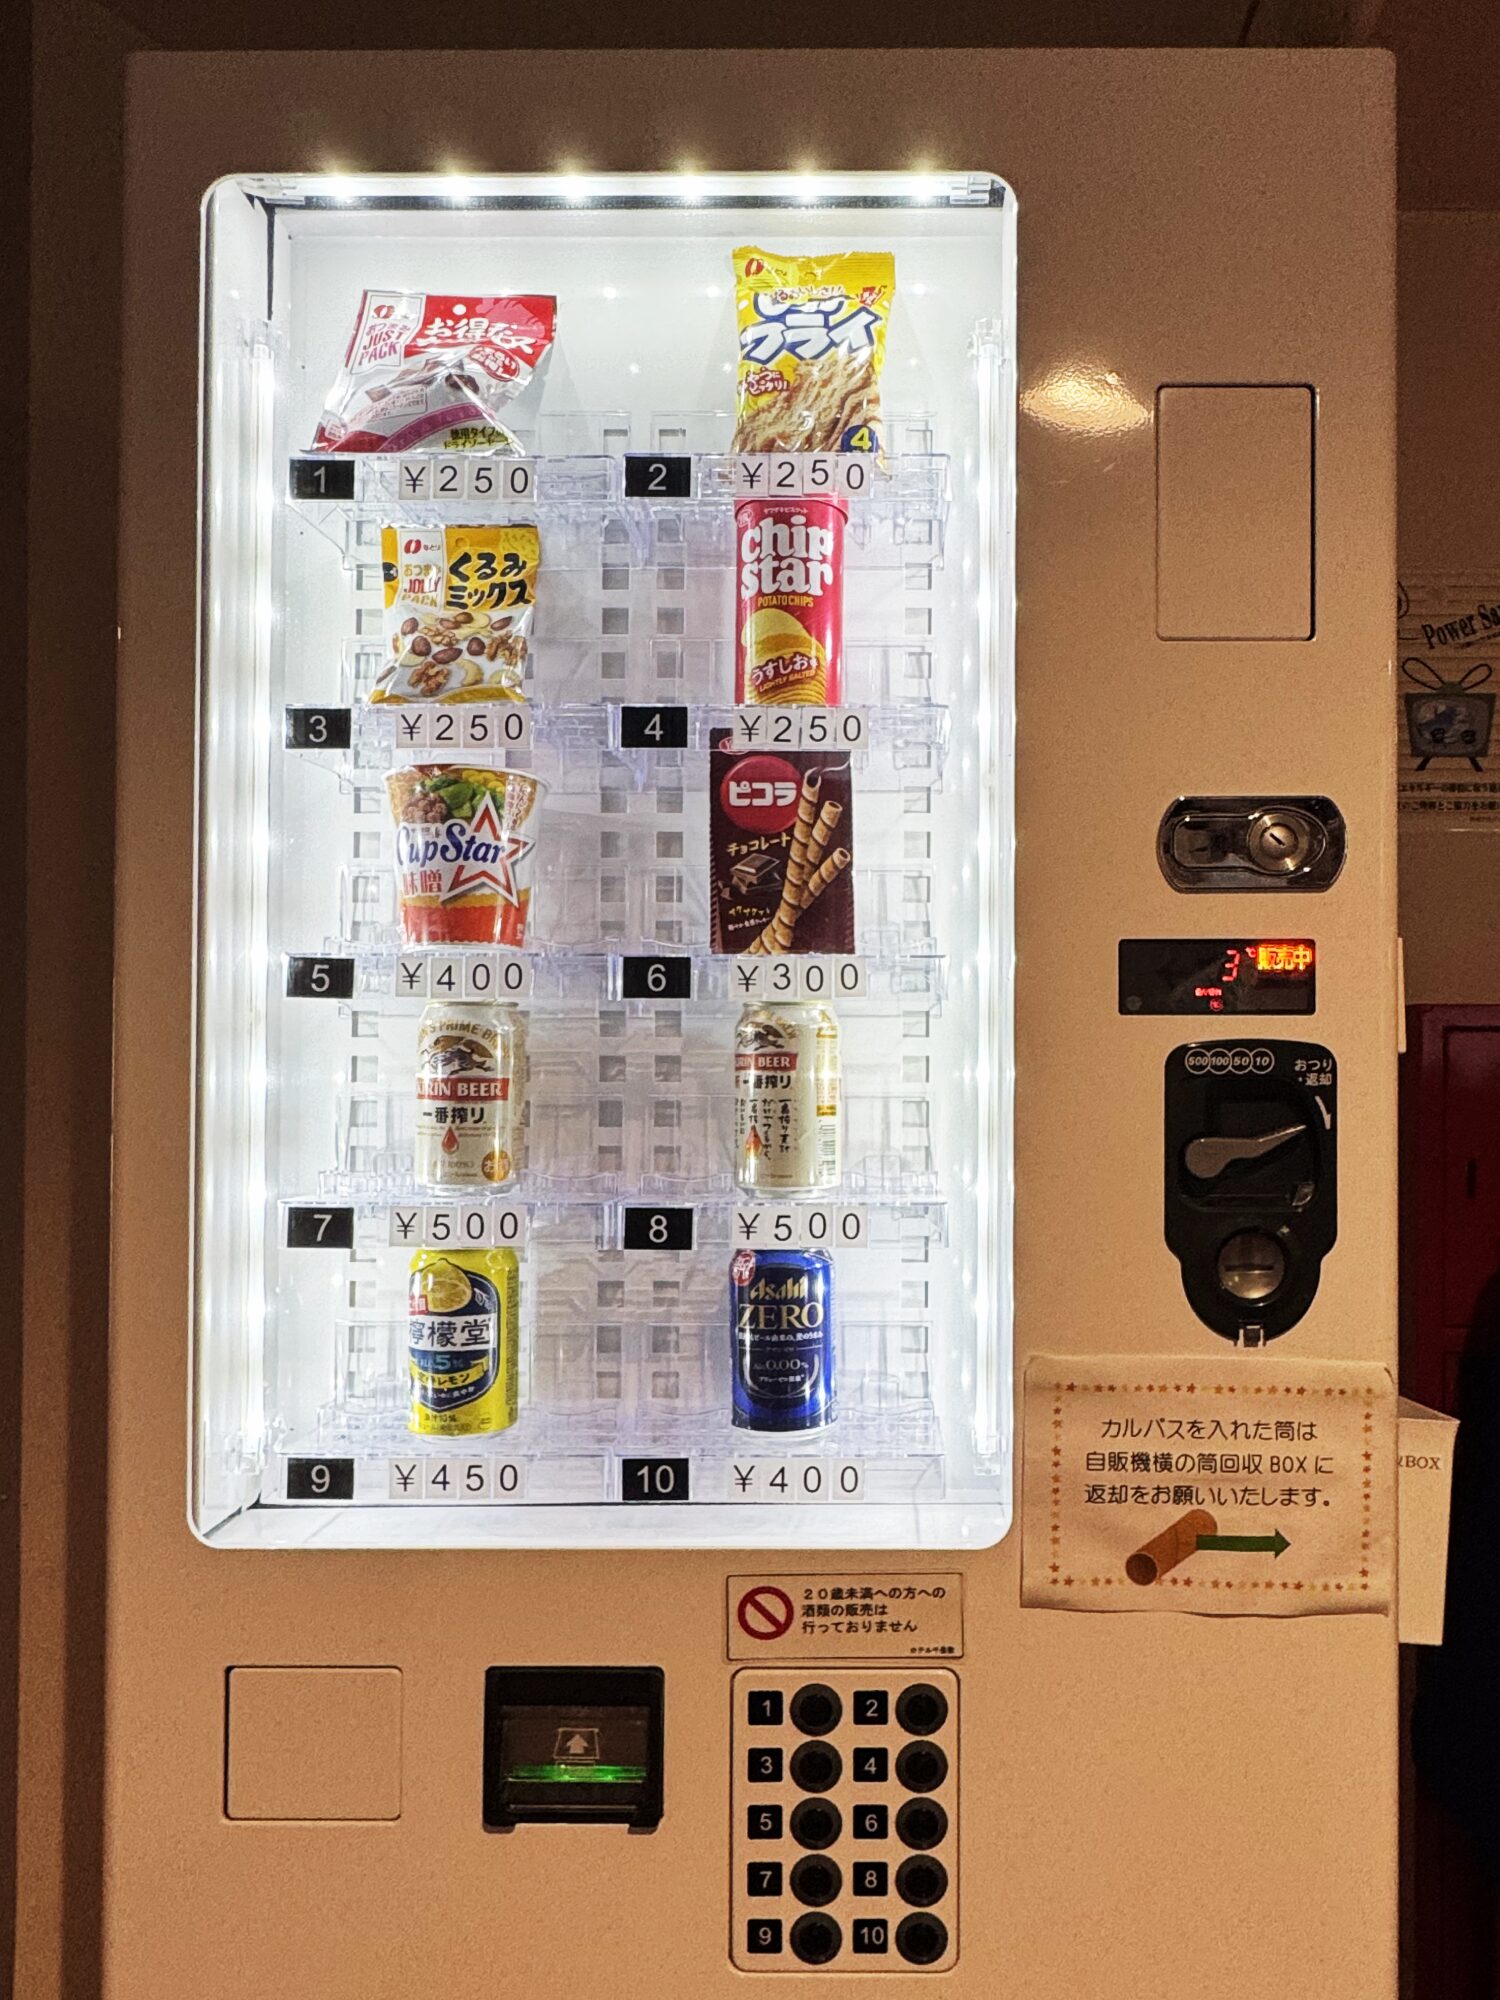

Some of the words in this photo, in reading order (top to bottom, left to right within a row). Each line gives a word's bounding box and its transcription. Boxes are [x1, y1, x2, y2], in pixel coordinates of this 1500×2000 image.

[363, 330, 404, 350] JUST
[850, 427, 872, 450] 4
[313, 466, 326, 492] 1
[404, 466, 529, 493] ¥250
[648, 463, 667, 491] 2
[741, 460, 864, 489] ¥250
[741, 515, 833, 562] chip
[449, 552, 527, 582] くるみ
[741, 554, 833, 598] star
[446, 579, 532, 609] ミックス
[1421, 614, 1476, 649] Power
[309, 716, 327, 742] 3
[401, 713, 523, 741] ¥250
[644, 714, 663, 741] 4
[740, 715, 861, 743] ¥250
[729, 781, 797, 807] ピコラ
[726, 832, 791, 856] チョコレート
[1222, 949, 1240, 982] 3
[1257, 944, 1312, 971] 販売中
[311, 965, 330, 992] 5
[401, 962, 523, 991] ¥400
[647, 964, 666, 991] 6
[737, 964, 858, 992] ¥300
[757, 1056, 791, 1068] BEER
[1188, 1056, 1209, 1066] 500
[1211, 1056, 1229, 1066] 100
[1233, 1056, 1249, 1066] 50
[1256, 1056, 1270, 1066] 10
[1294, 1059, 1332, 1072] おつり
[457, 1082, 504, 1097] BEER
[423, 1106, 485, 1124] 一番搾り
[313, 1214, 332, 1242] 7
[395, 1212, 518, 1241] ¥500
[649, 1215, 668, 1243] 8
[738, 1212, 861, 1241] ¥500
[750, 1277, 806, 1300] Asahi
[738, 1302, 824, 1330] ZERO
[1101, 1418, 1318, 1441] カルパスを入れた筒は
[395, 1464, 518, 1492] ¥450
[1269, 1455, 1308, 1475] BOX
[311, 1465, 330, 1493] 9
[637, 1465, 675, 1493] 10
[734, 1465, 858, 1493] ¥400
[1085, 1484, 1331, 1508] 返却をお願いいたします。
[802, 1603, 888, 1618] 酒類の販売は
[802, 1620, 918, 1635] 行っておりません
[762, 1699, 771, 1717] 1
[865, 1699, 878, 1717] 2
[760, 1757, 773, 1774] 3
[864, 1757, 877, 1774] 4
[760, 1814, 772, 1831] 5
[865, 1814, 878, 1831] 6
[760, 1871, 773, 1888] 7
[864, 1871, 877, 1888] 8
[759, 1927, 772, 1945] 9
[860, 1927, 885, 1945] 10
